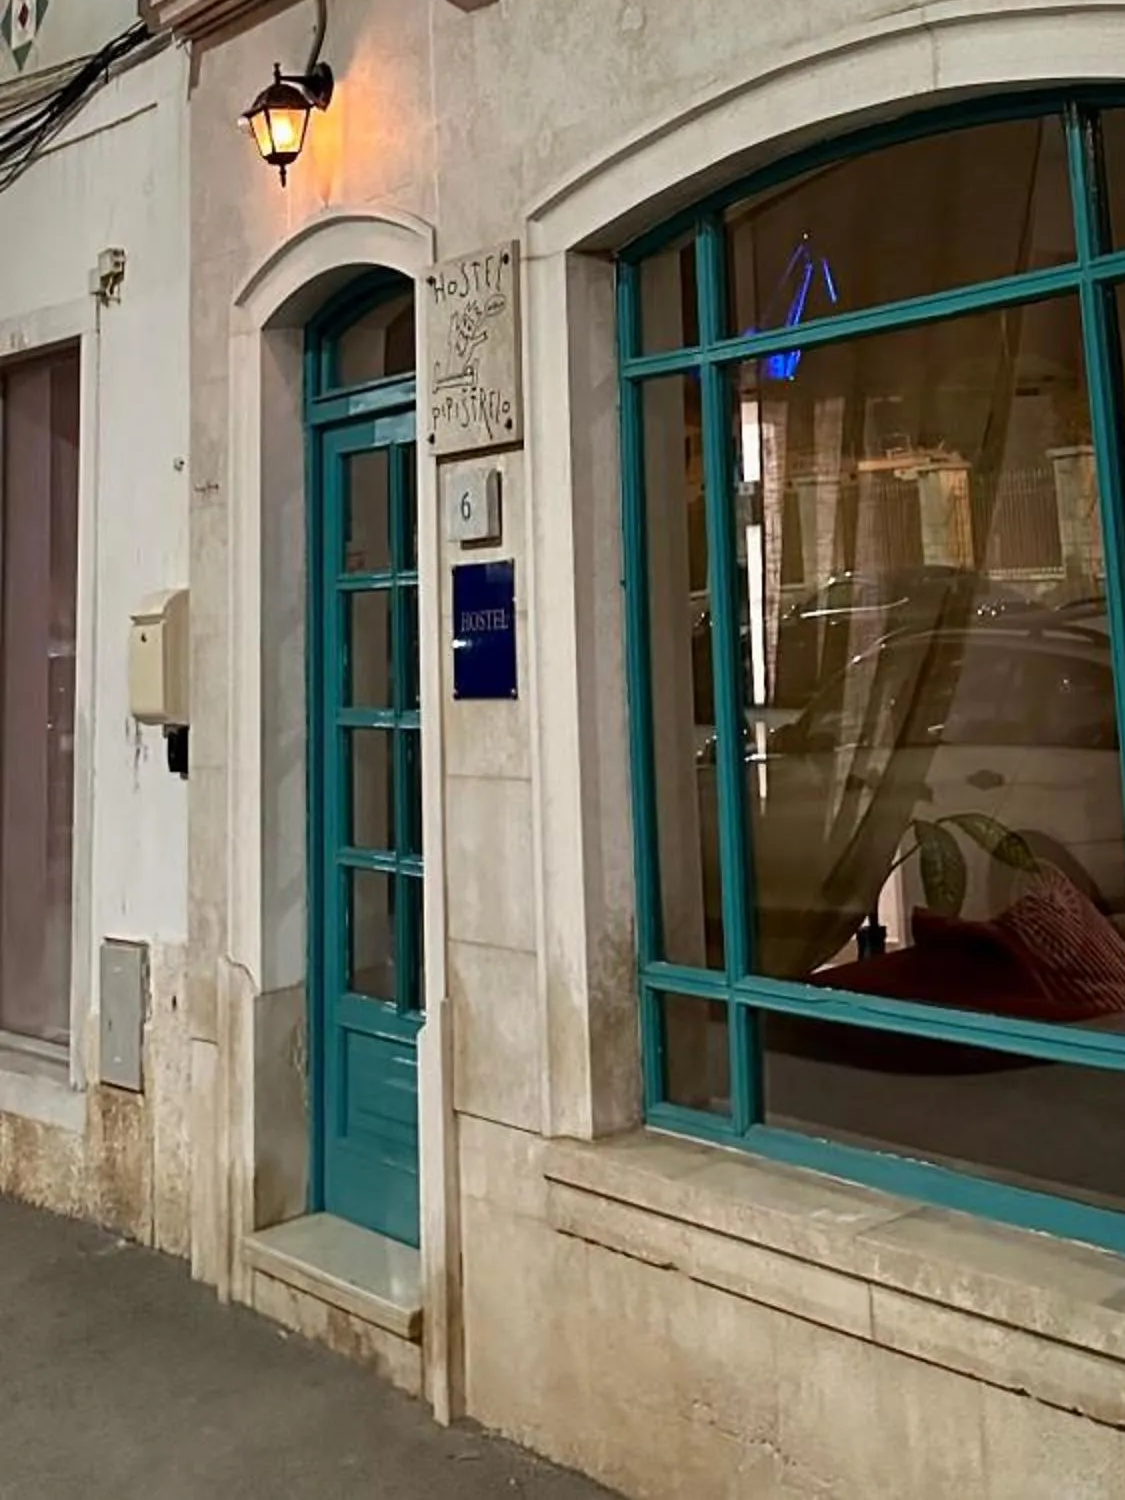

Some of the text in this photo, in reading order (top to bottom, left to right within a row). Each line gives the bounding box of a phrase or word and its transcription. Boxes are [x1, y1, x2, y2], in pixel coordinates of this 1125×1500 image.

[433, 252, 503, 304] HOSTEL
[460, 491, 472, 521] 6
[460, 608, 509, 633] HOSTEL
